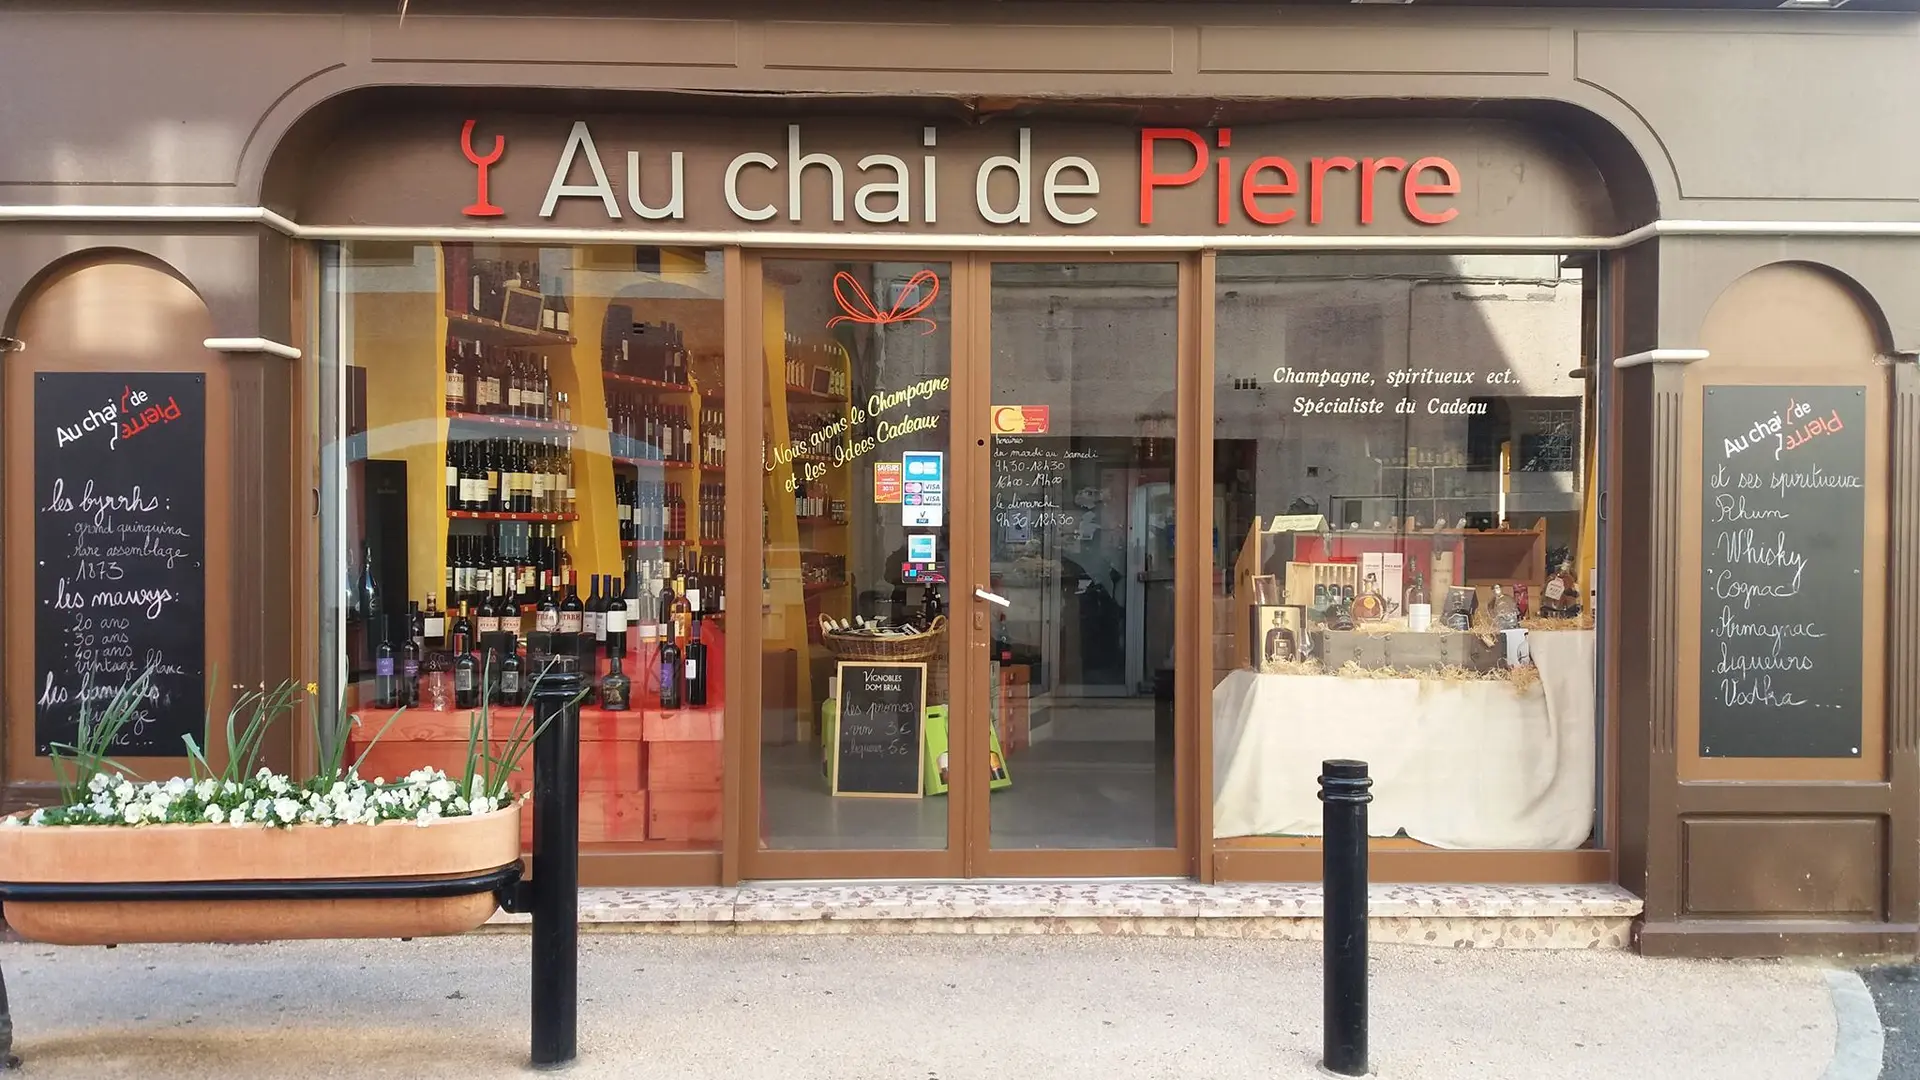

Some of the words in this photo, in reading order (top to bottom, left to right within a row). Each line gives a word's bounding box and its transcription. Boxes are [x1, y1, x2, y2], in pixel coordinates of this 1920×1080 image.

[538, 120, 684, 220] Au
[724, 123, 937, 223] chai
[974, 127, 1101, 226] de
[1139, 126, 1463, 225] Pierre
[1273, 367, 1376, 388] Champagne,
[1386, 368, 1475, 387] spiritueux
[56, 422, 83, 448] Au
[82, 399, 118, 432] chai
[129, 389, 149, 407] de
[121, 396, 182, 439] Pierre
[1293, 396, 1384, 415] Spécialiste
[1395, 397, 1416, 414] du
[1427, 397, 1488, 415] Cadeau
[765, 438, 807, 472] Nous
[810, 417, 848, 448] avons
[850, 405, 865, 425] le
[868, 376, 950, 418] Champagne
[1723, 435, 1749, 459] Au
[1748, 409, 1782, 443] chai
[1794, 401, 1812, 418] de
[1786, 408, 1844, 451] Pierre
[785, 472, 799, 494] et
[804, 462, 826, 483] les
[876, 413, 940, 444] Cadeaux
[1063, 447, 1099, 459] samedi
[1711, 463, 1731, 489] et
[1738, 472, 1764, 489] ses
[1770, 463, 1864, 499] spiritueux
[1007, 493, 1060, 510] dimanche
[1715, 493, 1790, 523] Rhum
[117, 520, 191, 543] quinquina
[106, 536, 189, 569] assemblage
[1717, 528, 1809, 594] Whisky
[75, 559, 125, 582] 1873
[1716, 569, 1796, 610] Cognac
[72, 612, 92, 632] 20
[100, 617, 130, 630] ans
[73, 632, 95, 646] 30
[101, 631, 129, 644] ans
[1716, 605, 1828, 656] Armagnac
[74, 648, 92, 661] 40
[103, 644, 133, 657] ans
[865, 683, 882, 691] DOM
[883, 683, 902, 692] BRIAL
